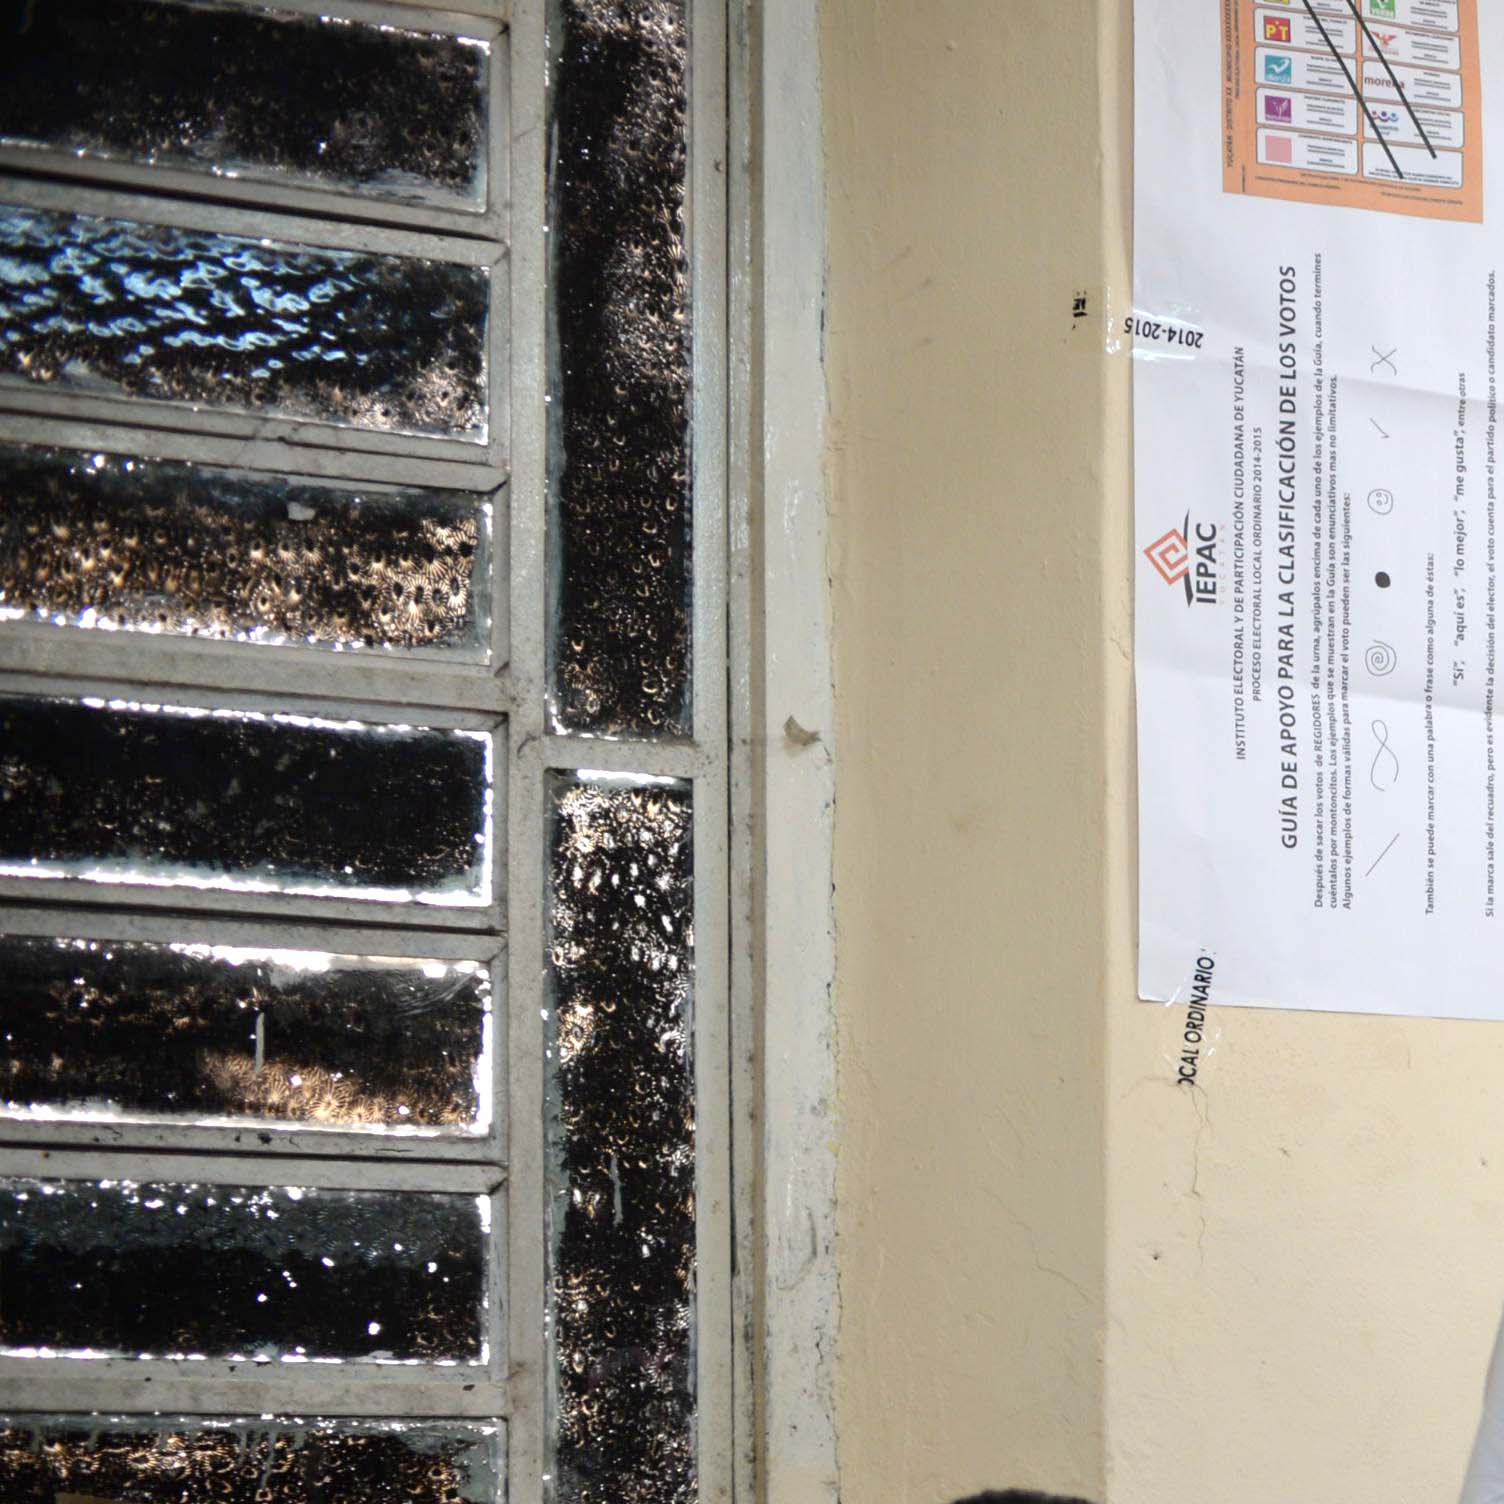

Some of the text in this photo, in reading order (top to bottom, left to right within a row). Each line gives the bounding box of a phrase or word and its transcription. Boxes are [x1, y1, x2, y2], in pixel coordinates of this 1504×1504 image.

[1312, 252, 1322, 298] termines
[1312, 300, 1322, 338] cuando
[1124, 317, 1204, 349] 2014-2015
[1486, 324, 1496, 376] candidato
[1313, 368, 1323, 377] la
[1313, 378, 1323, 392] de
[1458, 372, 1466, 398] otras
[1488, 376, 1496, 384] o
[1457, 398, 1467, 427] entre
[1486, 384, 1497, 423] político
[1313, 394, 1325, 442] ejemplos
[1312, 443, 1322, 459] los
[1329, 434, 1337, 449] no
[1485, 424, 1496, 464] partido
[1312, 460, 1322, 475] de
[1329, 450, 1337, 472] mas
[1485, 464, 1494, 475] el
[1314, 476, 1322, 497] uno
[1487, 476, 1497, 500] para
[1312, 499, 1322, 524] cada
[1327, 473, 1337, 540] enunciativos
[1486, 501, 1495, 536] cuenta
[1312, 526, 1322, 540] de
[1232, 346, 1246, 760] INSTITUTO ELECTORAL Y DE PARTICIPACIÓN CIUDADANA DE YUCATÁN
[1276, 265, 1298, 849] GUÍA DE APOYO PARA LA CLASIFICACIÓN DE LOS VOTOS
[1311, 541, 1322, 579] encima
[1328, 542, 1336, 560] son
[1340, 551, 1350, 566] las
[1487, 537, 1495, 561] voto
[1195, 523, 1217, 605] IEPAC
[1251, 427, 1262, 702] PROCESO ELECTORAL LOCAL ORDINARIO 2014-2015
[1326, 562, 1336, 587] Guía
[1342, 568, 1350, 584] ser
[1486, 562, 1495, 573] el
[1326, 589, 1336, 599] la
[1424, 584, 1434, 598] de
[1310, 580, 1323, 634] agrúpalos
[1328, 600, 1336, 614] en
[1340, 586, 1352, 626] pueden
[1425, 599, 1437, 636] alguna
[1486, 613, 1496, 630] del
[1326, 616, 1335, 666] muestran
[1341, 627, 1350, 652] voto
[1426, 636, 1434, 666] como
[1340, 653, 1350, 664] el
[1485, 632, 1496, 675] decisión
[1310, 664, 1320, 674] la
[1327, 667, 1335, 679] se
[1423, 667, 1434, 694] frase
[1485, 676, 1494, 687] la
[1310, 675, 1320, 690] de
[1327, 680, 1336, 700] que
[1341, 665, 1349, 701] marcar
[1424, 694, 1433, 703] o
[1483, 688, 1496, 733] evidente
[1310, 694, 1323, 752] REGIDORES
[1326, 702, 1339, 747] ejemplos
[1342, 703, 1352, 725] para
[1424, 704, 1436, 742] palabra
[1341, 726, 1352, 762] válidas
[1486, 734, 1494, 746] es
[1314, 754, 1323, 768] de
[1328, 749, 1337, 766] Los
[1427, 743, 1435, 763] una
[1487, 746, 1496, 771] pero
[1315, 771, 1324, 800] votos
[1342, 764, 1352, 800] formas
[1427, 764, 1435, 784] con
[1314, 802, 1324, 818] los
[1342, 802, 1352, 816] de
[1427, 784, 1435, 821] marcar
[1316, 819, 1324, 846] sacar
[1342, 817, 1354, 865] ejemplos
[1425, 822, 1437, 856] puede
[1485, 822, 1494, 840] del
[1314, 848, 1324, 862] de
[1330, 838, 1340, 857] por
[1485, 840, 1495, 862] sale
[1427, 857, 1435, 869] se
[1314, 863, 1326, 908] Después
[1328, 858, 1338, 909] cuéntalos
[1342, 866, 1354, 910] Algunos
[1487, 863, 1495, 895] marca
[1424, 870, 1434, 915] También
[1485, 896, 1494, 906] la
[1485, 908, 1494, 918] Si
[1184, 956, 1215, 1044] ORDINARIO
